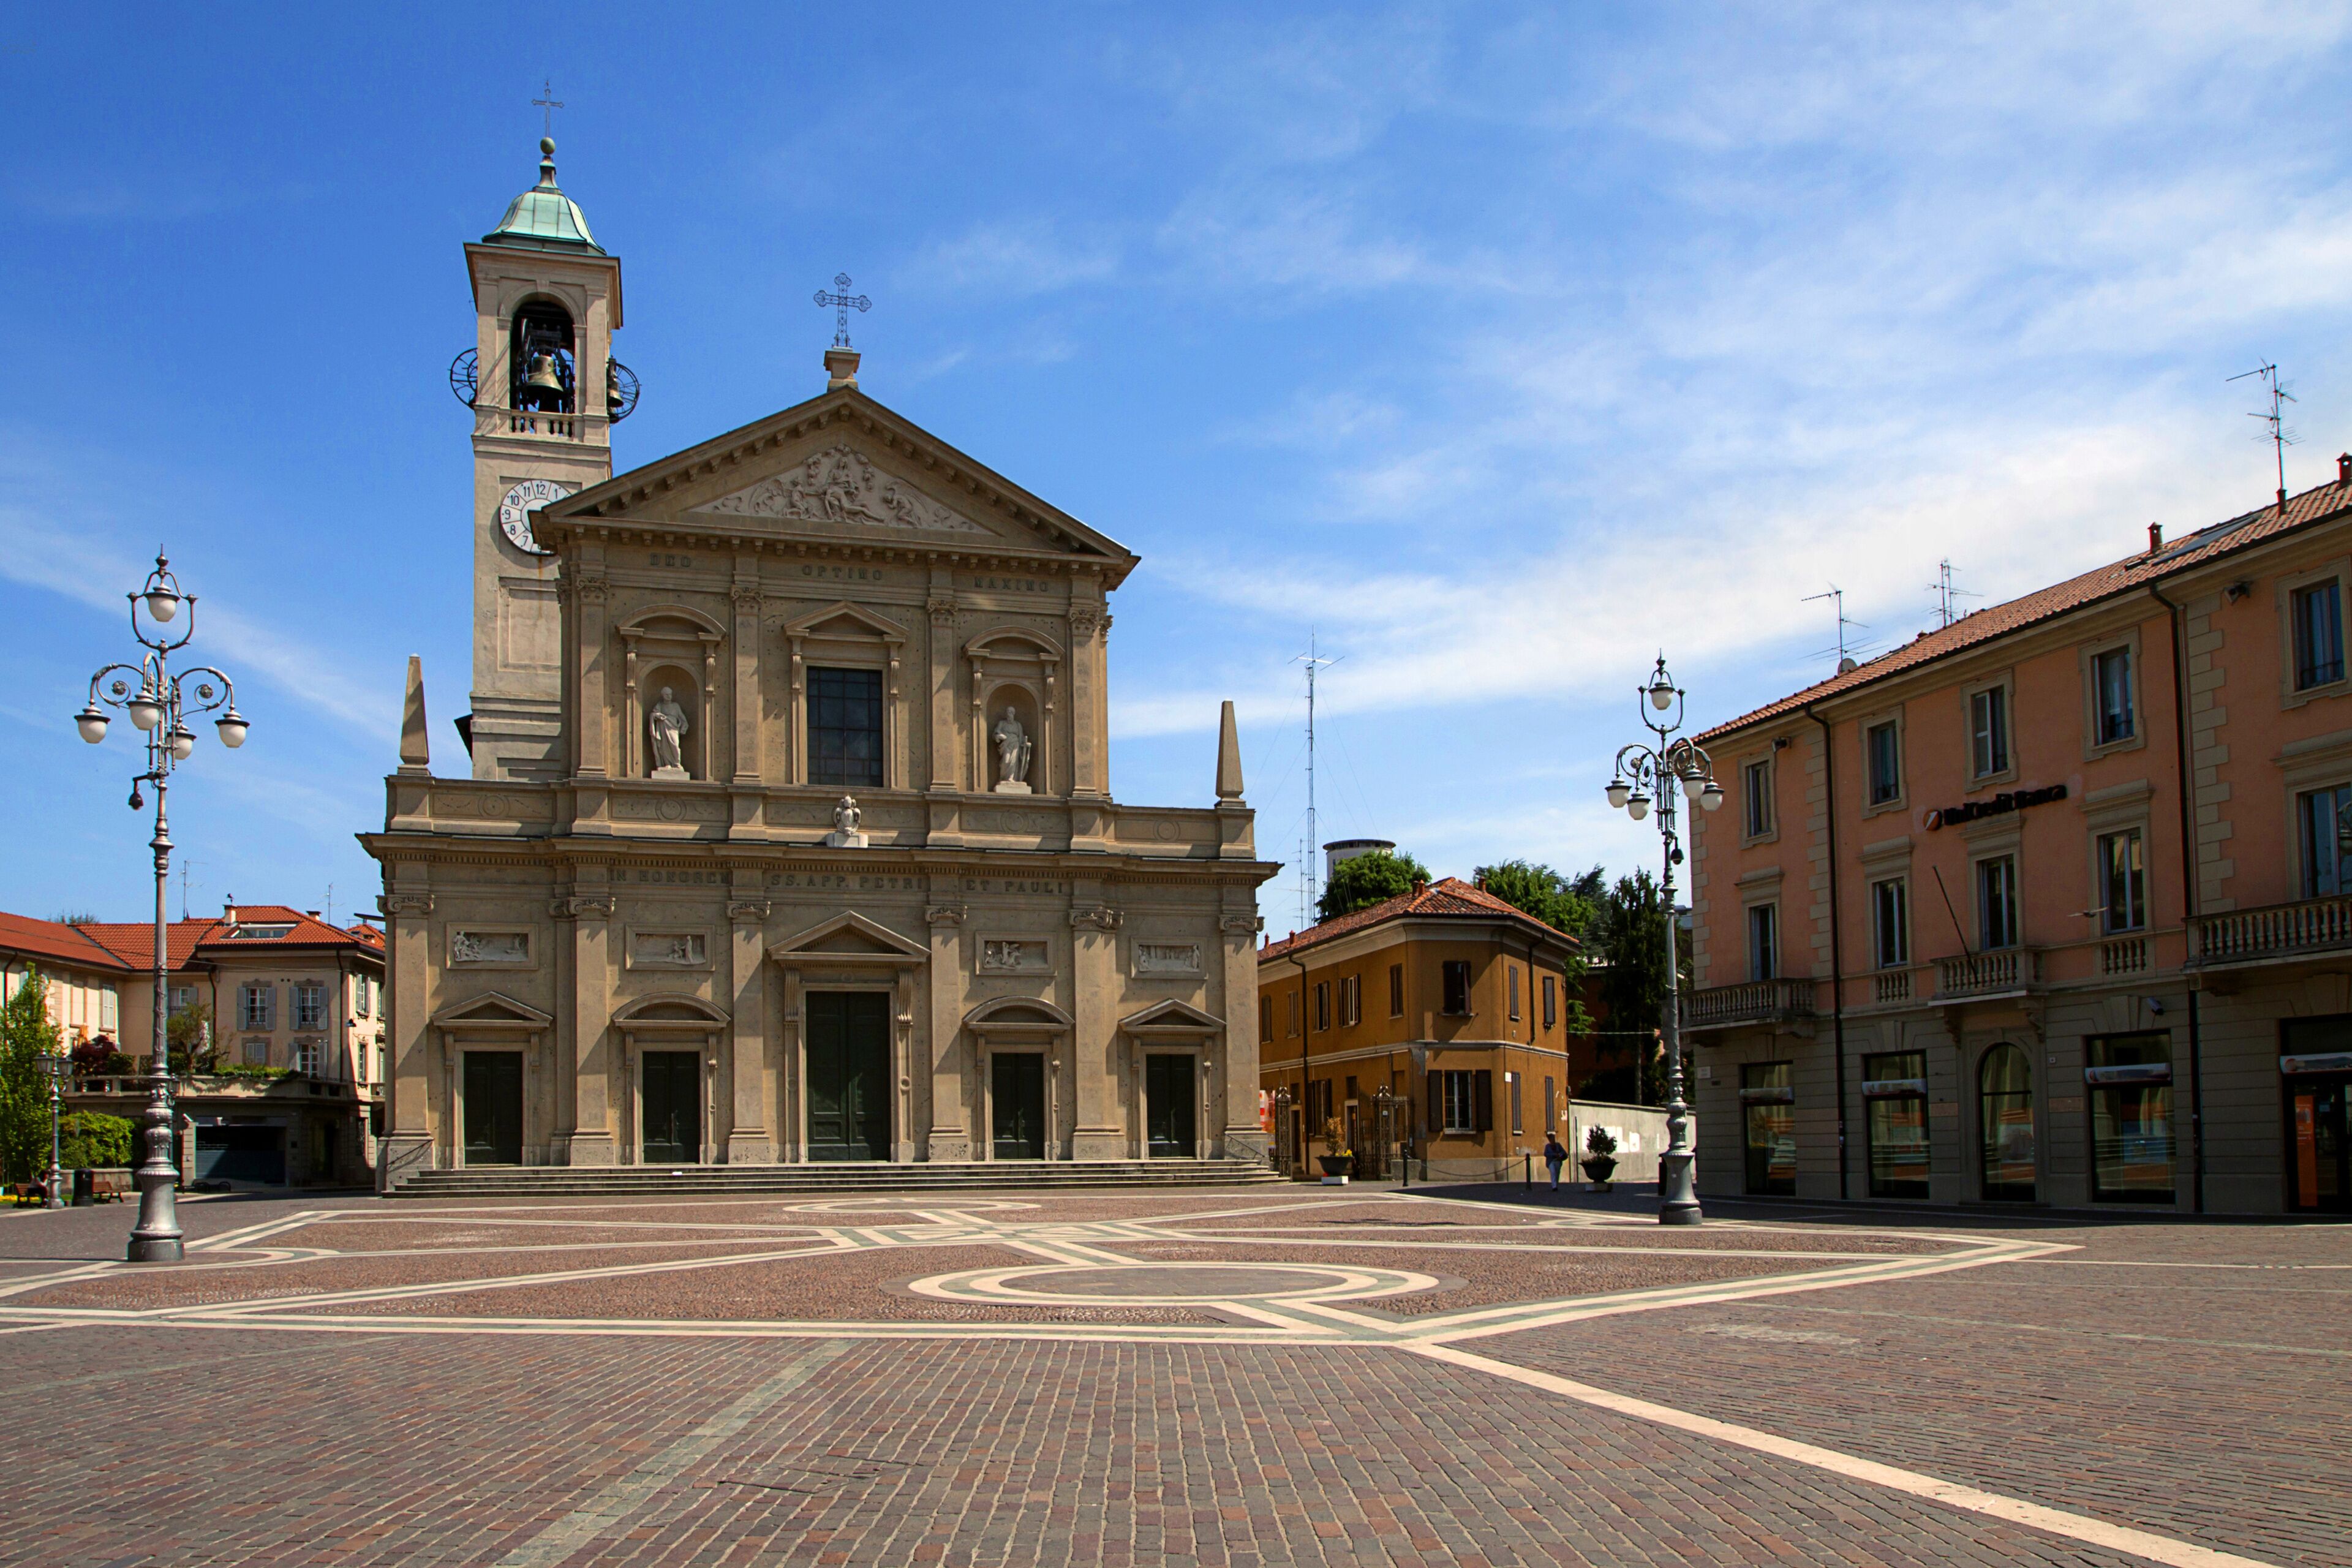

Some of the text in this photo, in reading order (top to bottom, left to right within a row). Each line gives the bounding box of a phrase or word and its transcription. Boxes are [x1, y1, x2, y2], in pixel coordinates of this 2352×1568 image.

[523, 486, 530, 497] 11
[536, 484, 546, 495] 12
[511, 495, 519, 506] 10
[505, 510, 510, 519] 9
[510, 525, 516, 535] 8
[522, 535, 529, 546] 7
[802, 565, 881, 580] OPTIMO
[974, 577, 1048, 592] MAXIMO
[610, 869, 626, 881] IN
[859, 877, 922, 889] PETRI
[967, 880, 990, 891] ET
[1005, 881, 1063, 894] PAULI
